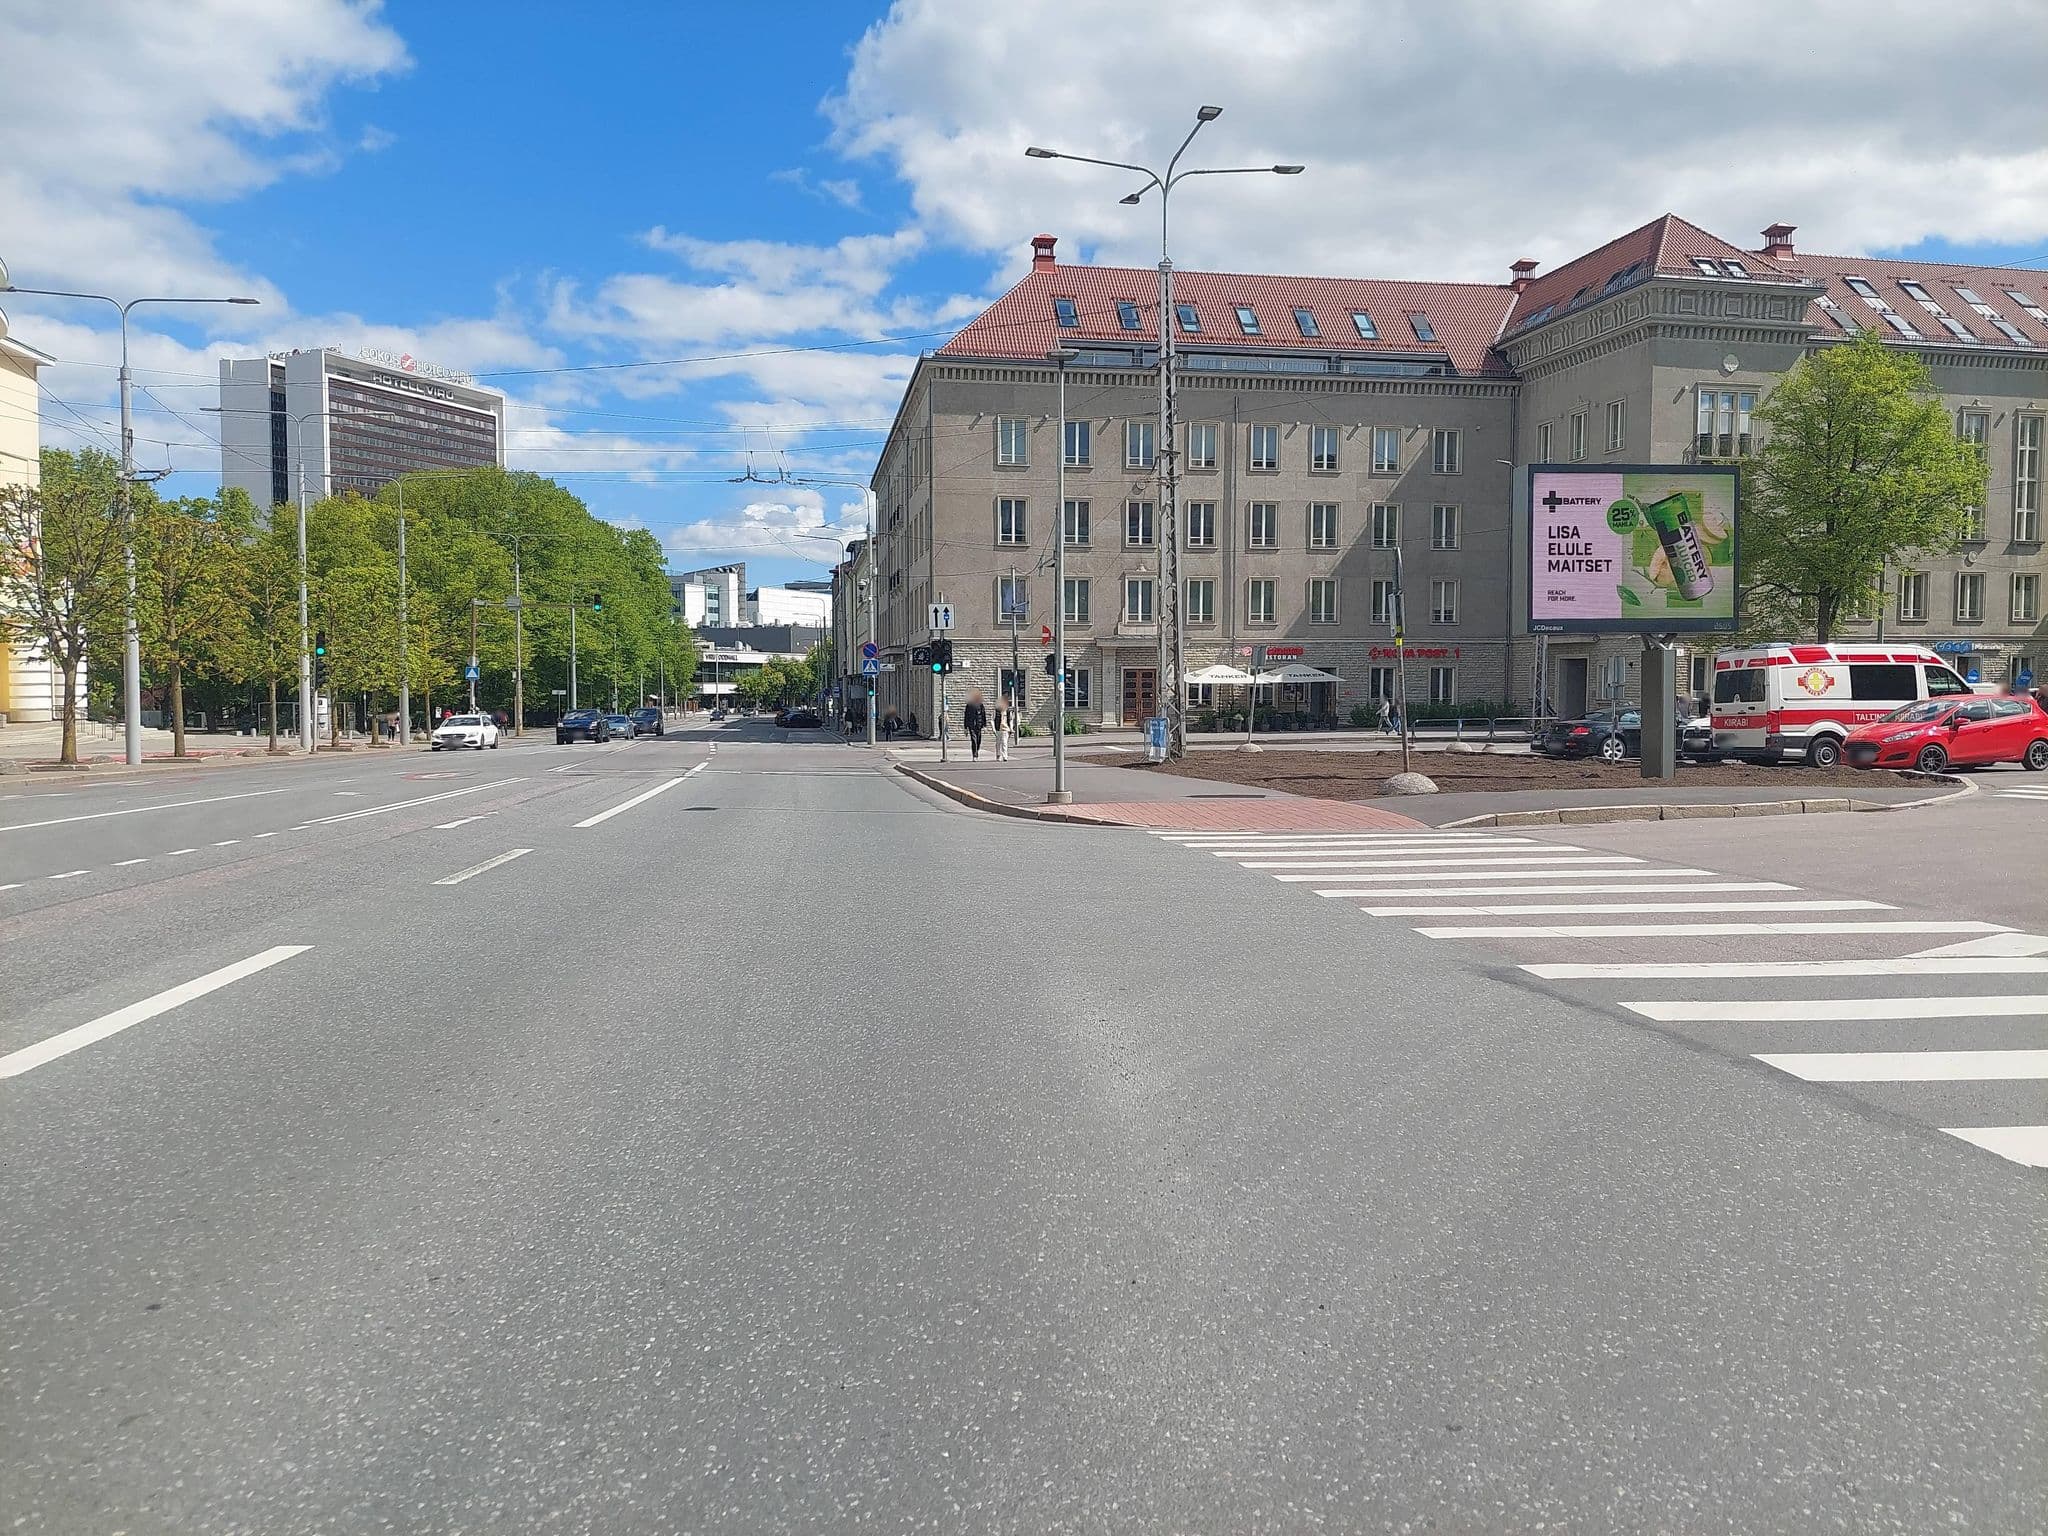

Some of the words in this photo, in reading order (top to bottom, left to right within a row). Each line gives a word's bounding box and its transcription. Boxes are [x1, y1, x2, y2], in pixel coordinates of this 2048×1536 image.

[426, 385, 454, 400] VIRU
[1563, 497, 1602, 505] BATTERY
[1548, 526, 1581, 539] LISA
[1548, 543, 1593, 556] ELULE
[1676, 511, 1708, 580] BATTERY
[1548, 559, 1613, 573] MAITSET
[1676, 544, 1697, 583] JUICED
[1724, 718, 1748, 727] KIIRABI
